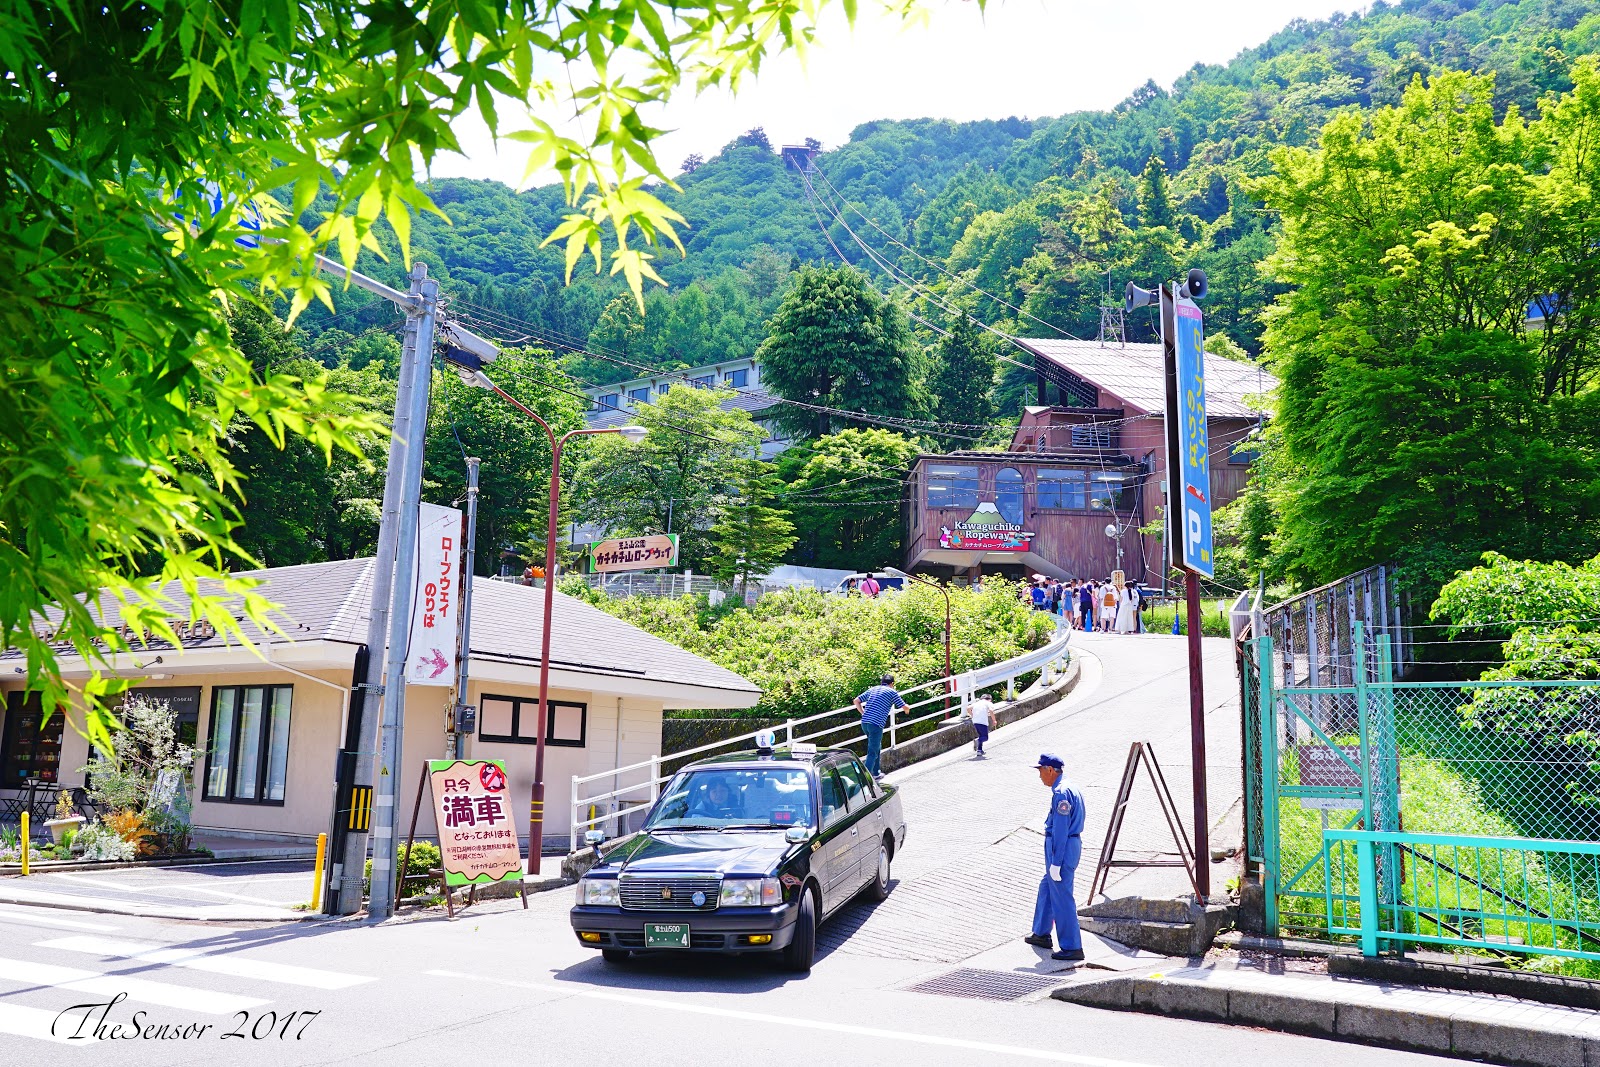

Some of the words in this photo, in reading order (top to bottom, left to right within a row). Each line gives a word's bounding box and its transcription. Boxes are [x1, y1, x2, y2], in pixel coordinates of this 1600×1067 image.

[1193, 327, 1207, 474] ロープウェイ
[1187, 389, 1199, 468] のりば
[954, 521, 1021, 532] Kawaguchiko
[965, 531, 1010, 541] Ropeway
[1188, 508, 1202, 556] P
[597, 546, 671, 565] カチカチ山ロープウェイ
[439, 536, 453, 618] ロープウェイ
[423, 582, 437, 629] のりば
[120, 618, 214, 642] CKIE
[444, 778, 470, 793] 只今
[443, 795, 505, 828] 満車
